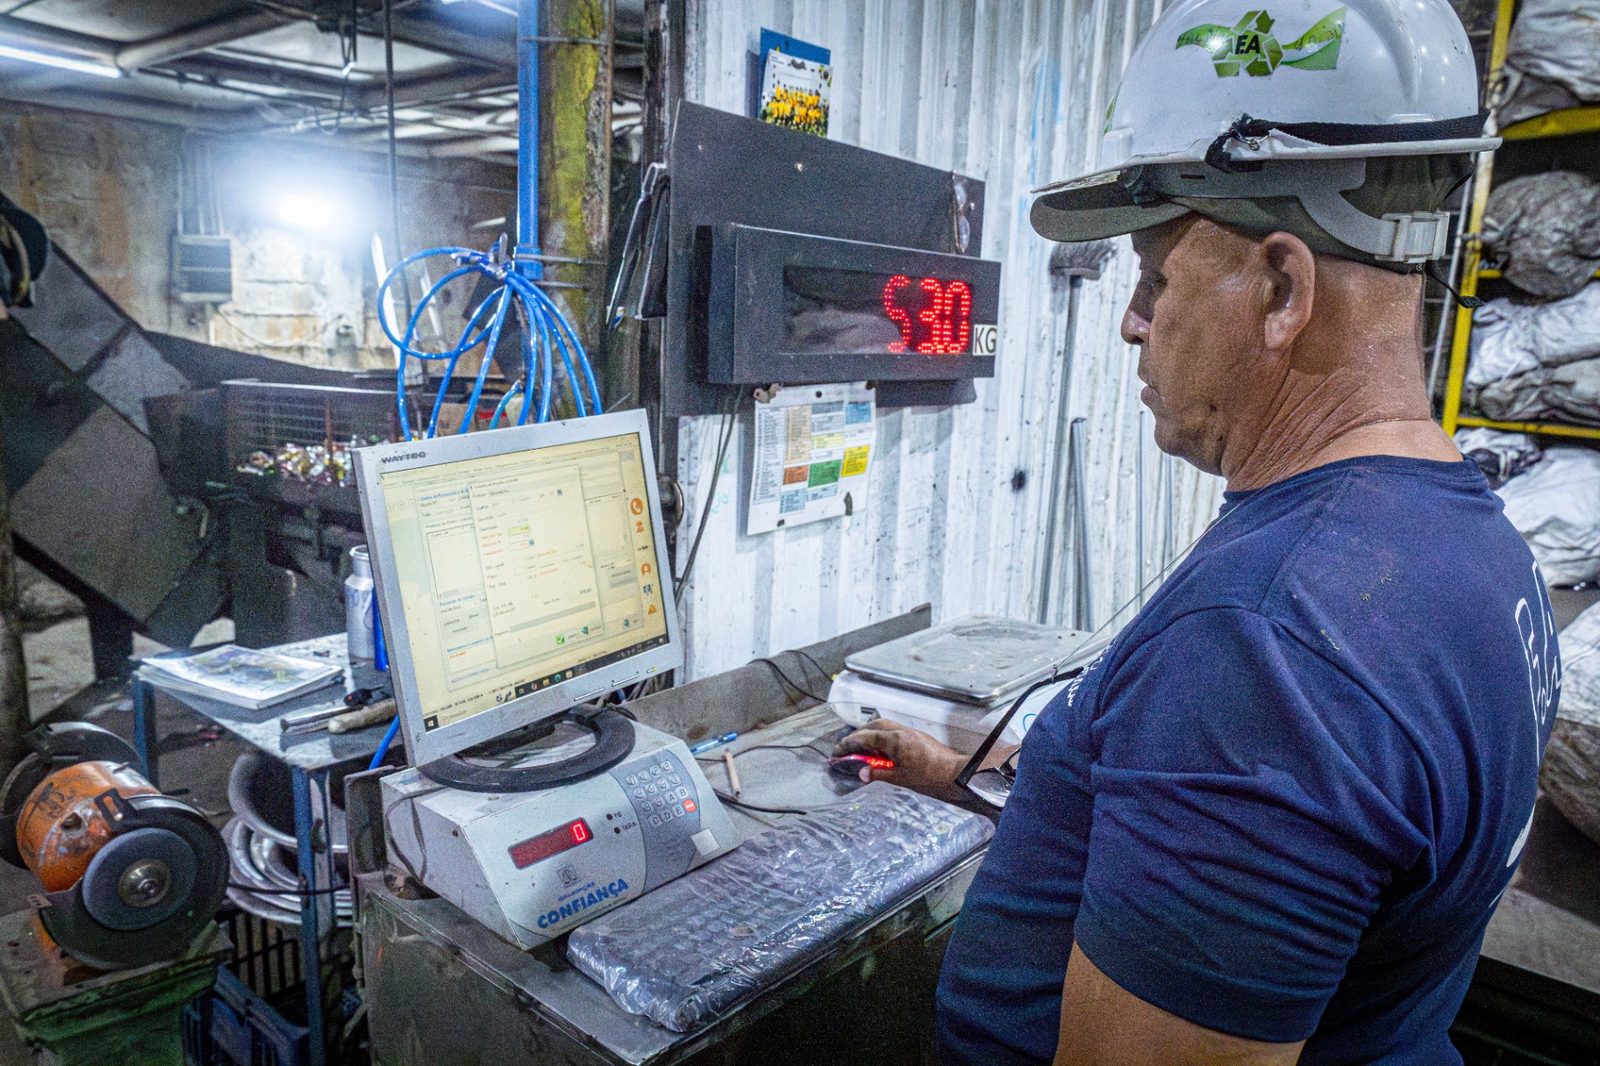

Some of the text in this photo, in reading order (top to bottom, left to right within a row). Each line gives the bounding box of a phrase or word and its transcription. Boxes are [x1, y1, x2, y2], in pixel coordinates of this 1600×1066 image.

[974, 327, 997, 354] KG
[573, 823, 586, 842] 0
[537, 878, 629, 930] CONFIANÇA
